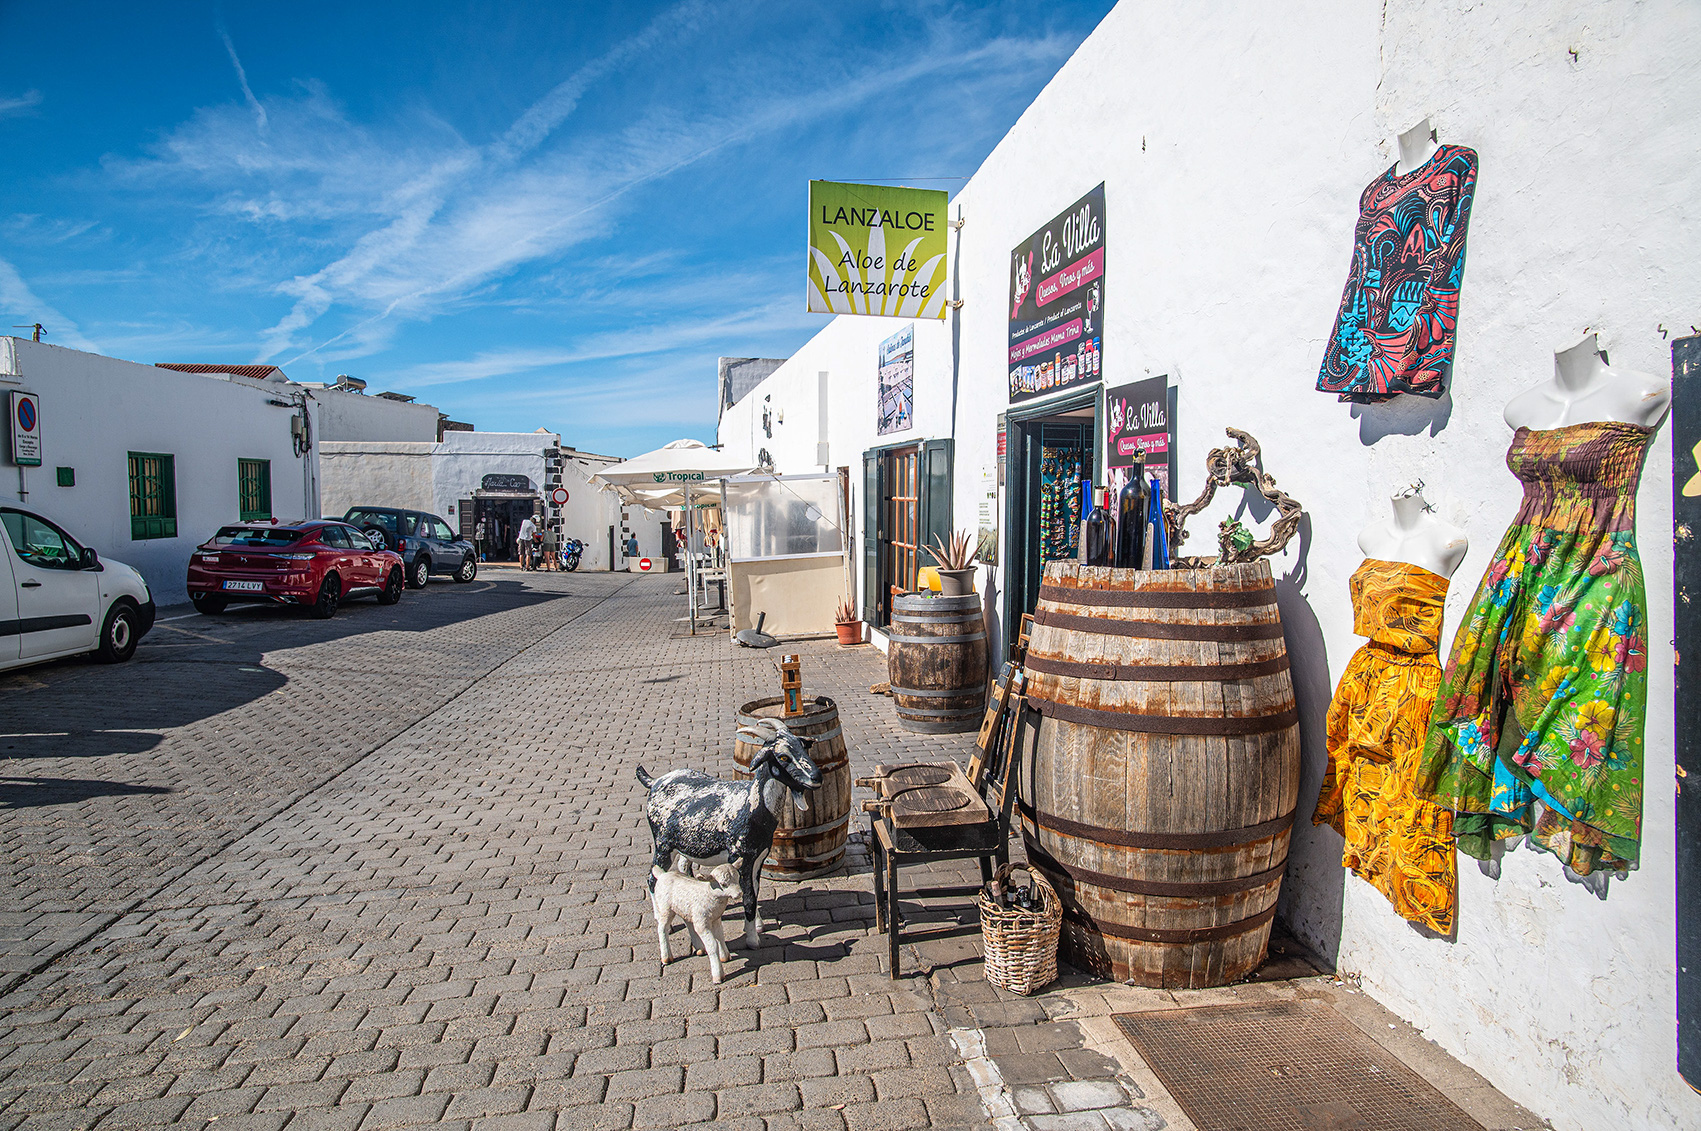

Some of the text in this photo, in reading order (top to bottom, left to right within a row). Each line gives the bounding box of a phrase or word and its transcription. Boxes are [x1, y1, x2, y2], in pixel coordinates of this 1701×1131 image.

[822, 205, 935, 232] LANZALOE
[1041, 203, 1100, 274] La Villa
[838, 249, 917, 272] Aloe de
[825, 275, 930, 298] Lanzarote
[1059, 271, 1076, 288] Vinos
[1076, 269, 1081, 287] y
[1126, 401, 1166, 431] La Villa
[667, 471, 705, 482] Tropical
[228, 581, 246, 589] 2714
